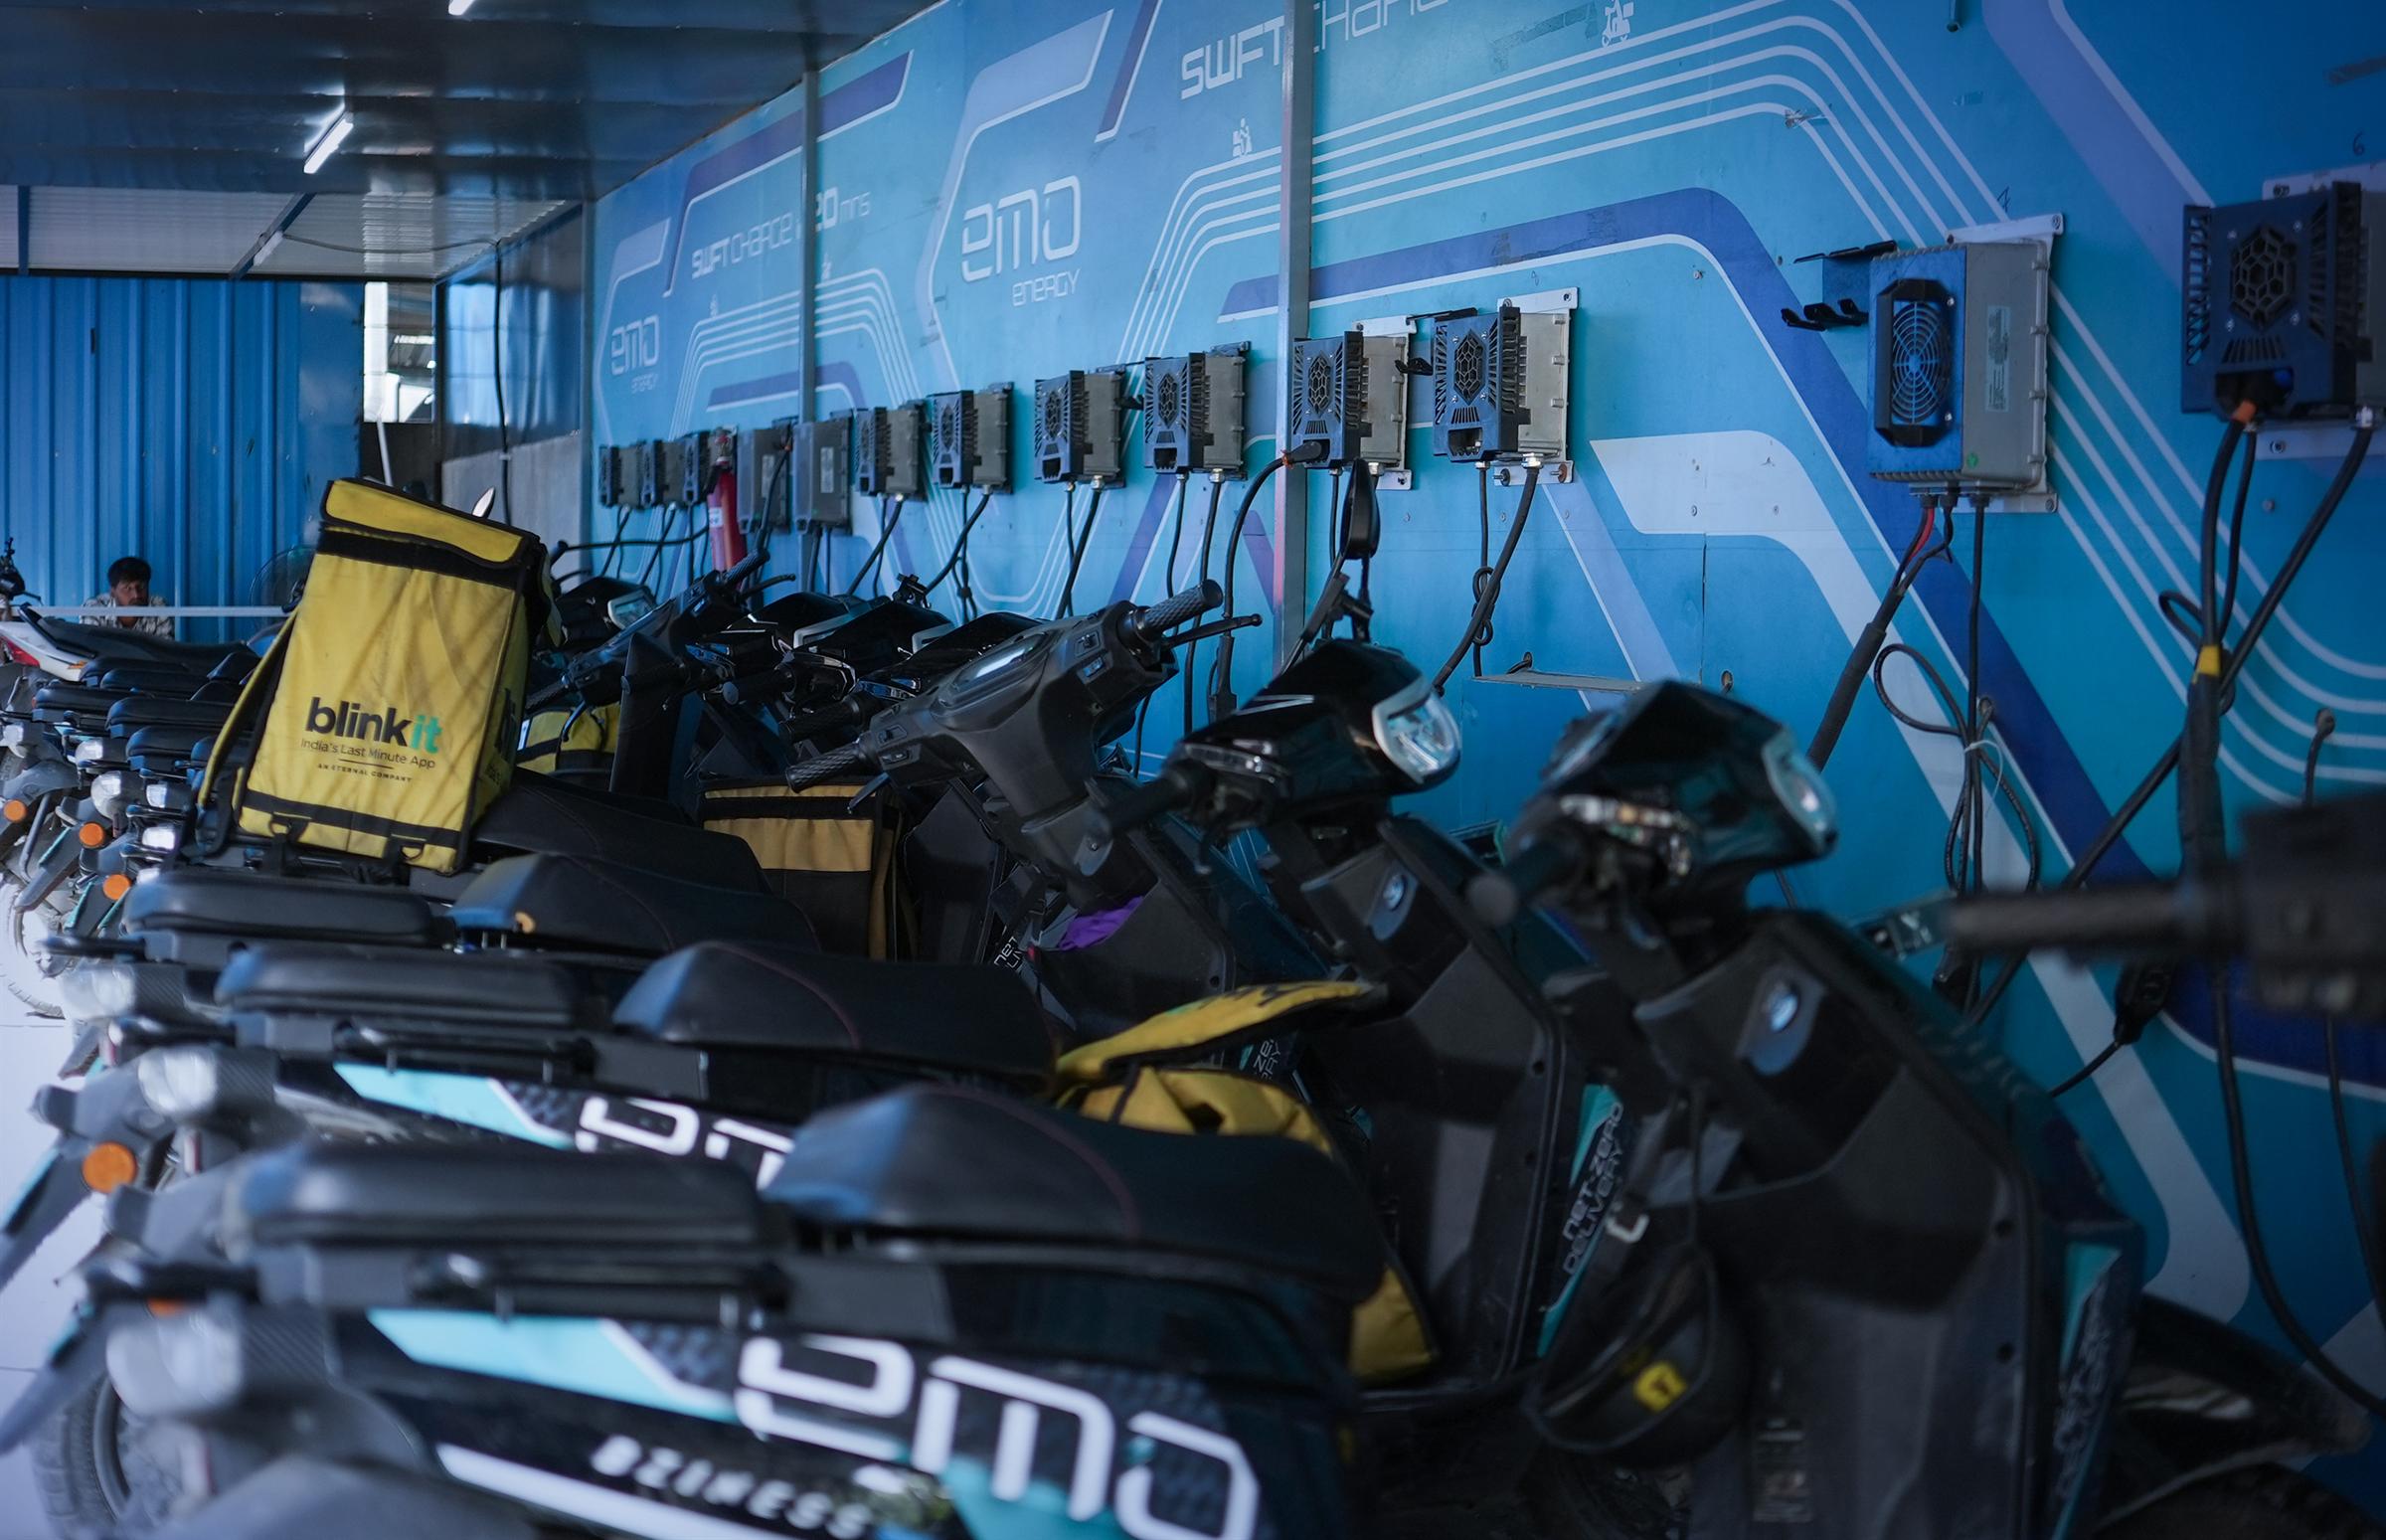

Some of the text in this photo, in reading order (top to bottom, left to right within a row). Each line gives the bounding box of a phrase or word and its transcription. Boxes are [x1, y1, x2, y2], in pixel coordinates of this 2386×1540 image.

[2352, 130, 2366, 156] 6
[305, 696, 444, 755] blinkit
[301, 738, 435, 770] India's Last Minute App
